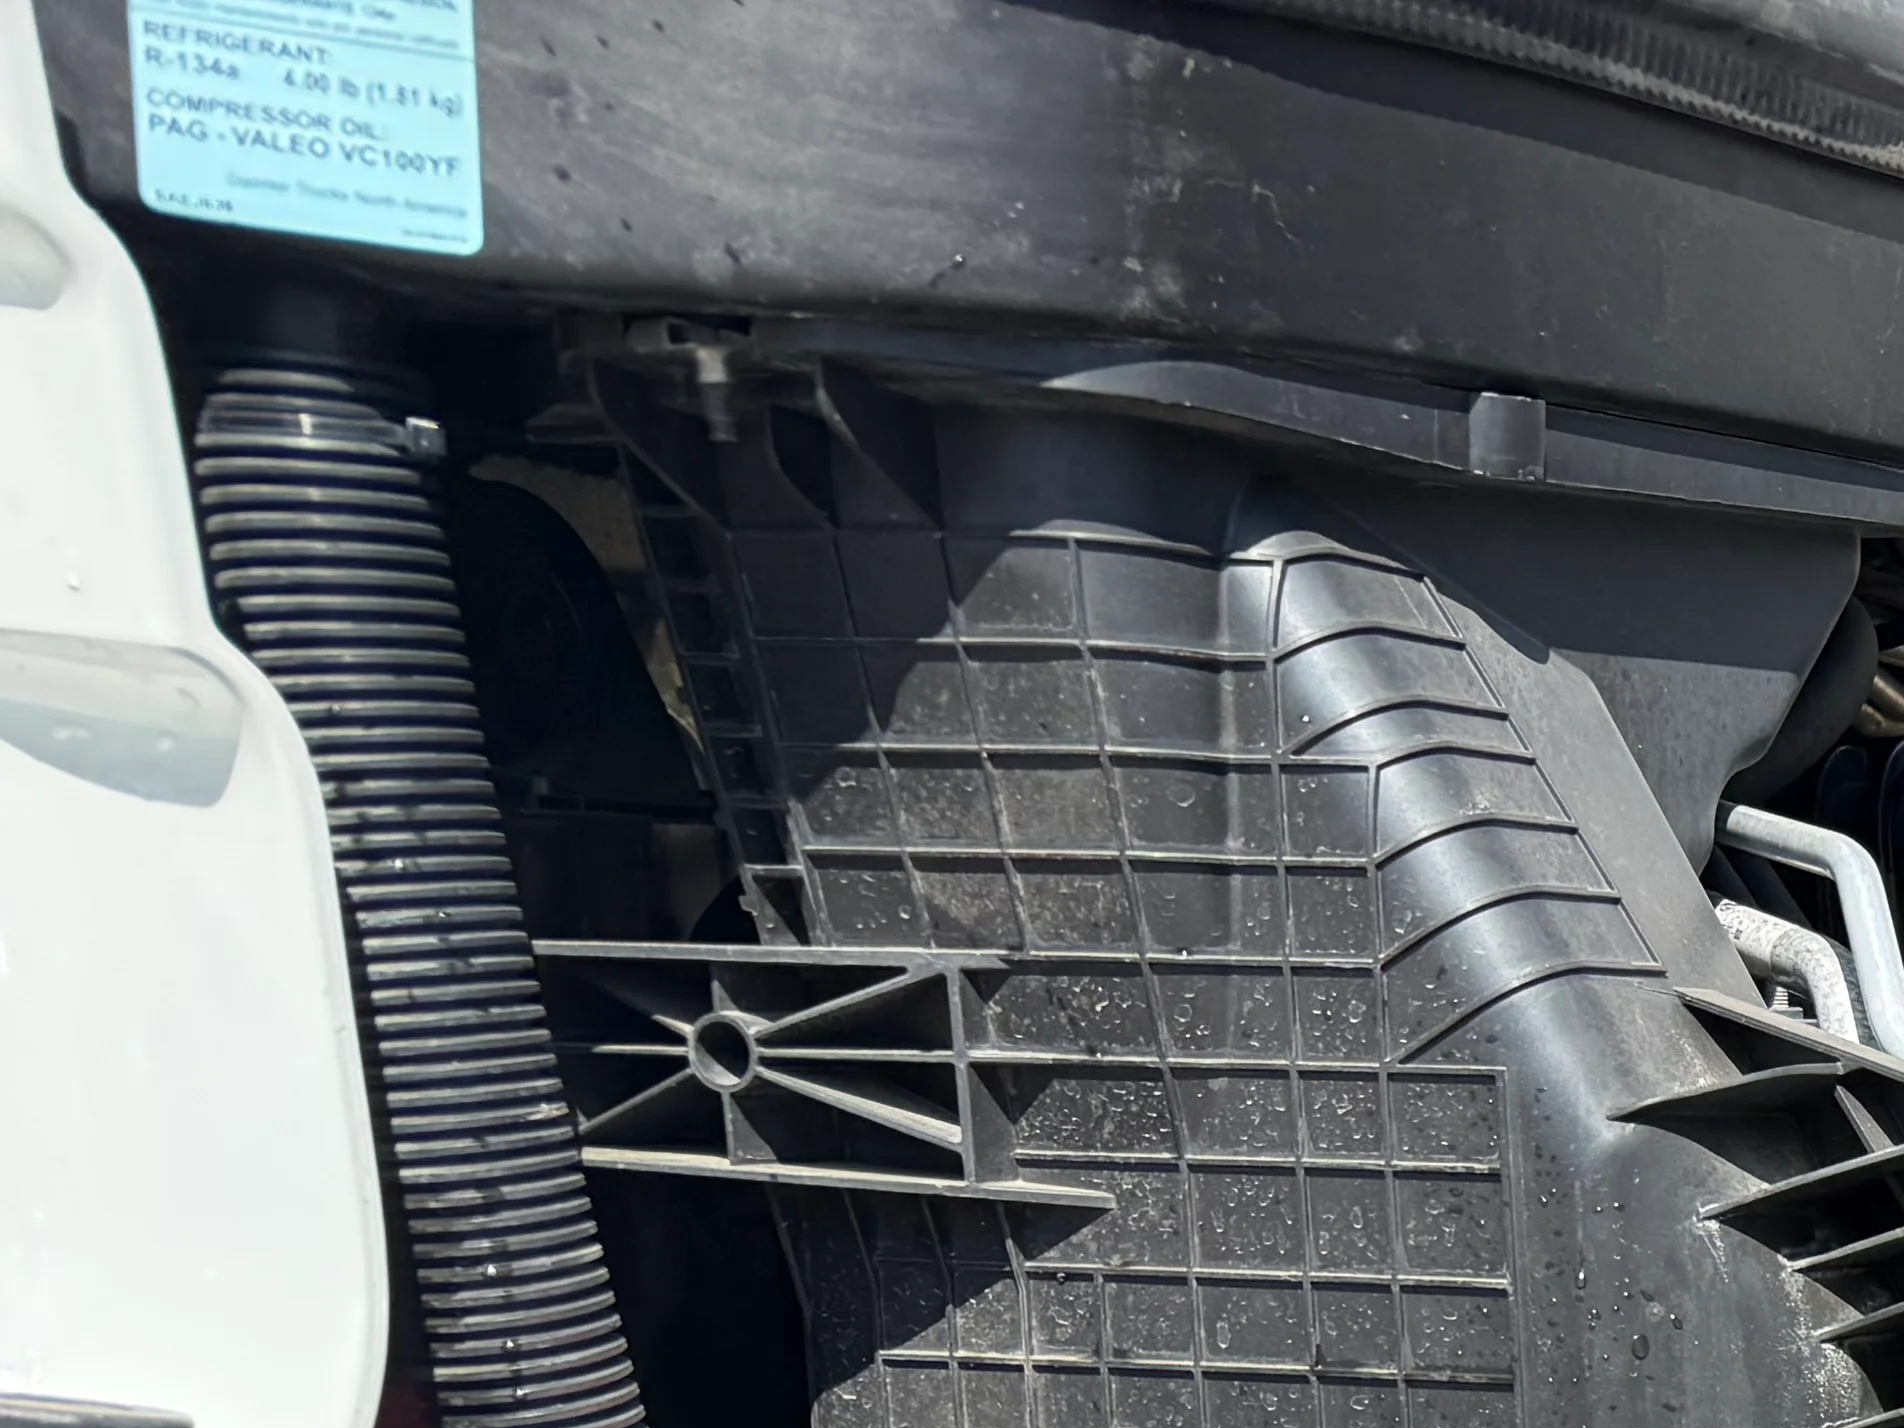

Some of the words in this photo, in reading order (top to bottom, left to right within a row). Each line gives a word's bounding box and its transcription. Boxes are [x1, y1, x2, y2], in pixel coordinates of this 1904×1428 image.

[145, 87, 332, 132] COMPRESSOR
[337, 75, 360, 99] lb
[428, 89, 464, 120] kg)
[148, 113, 209, 142] PAG
[230, 125, 330, 159] VALEO
[338, 141, 460, 178] VC100YF
